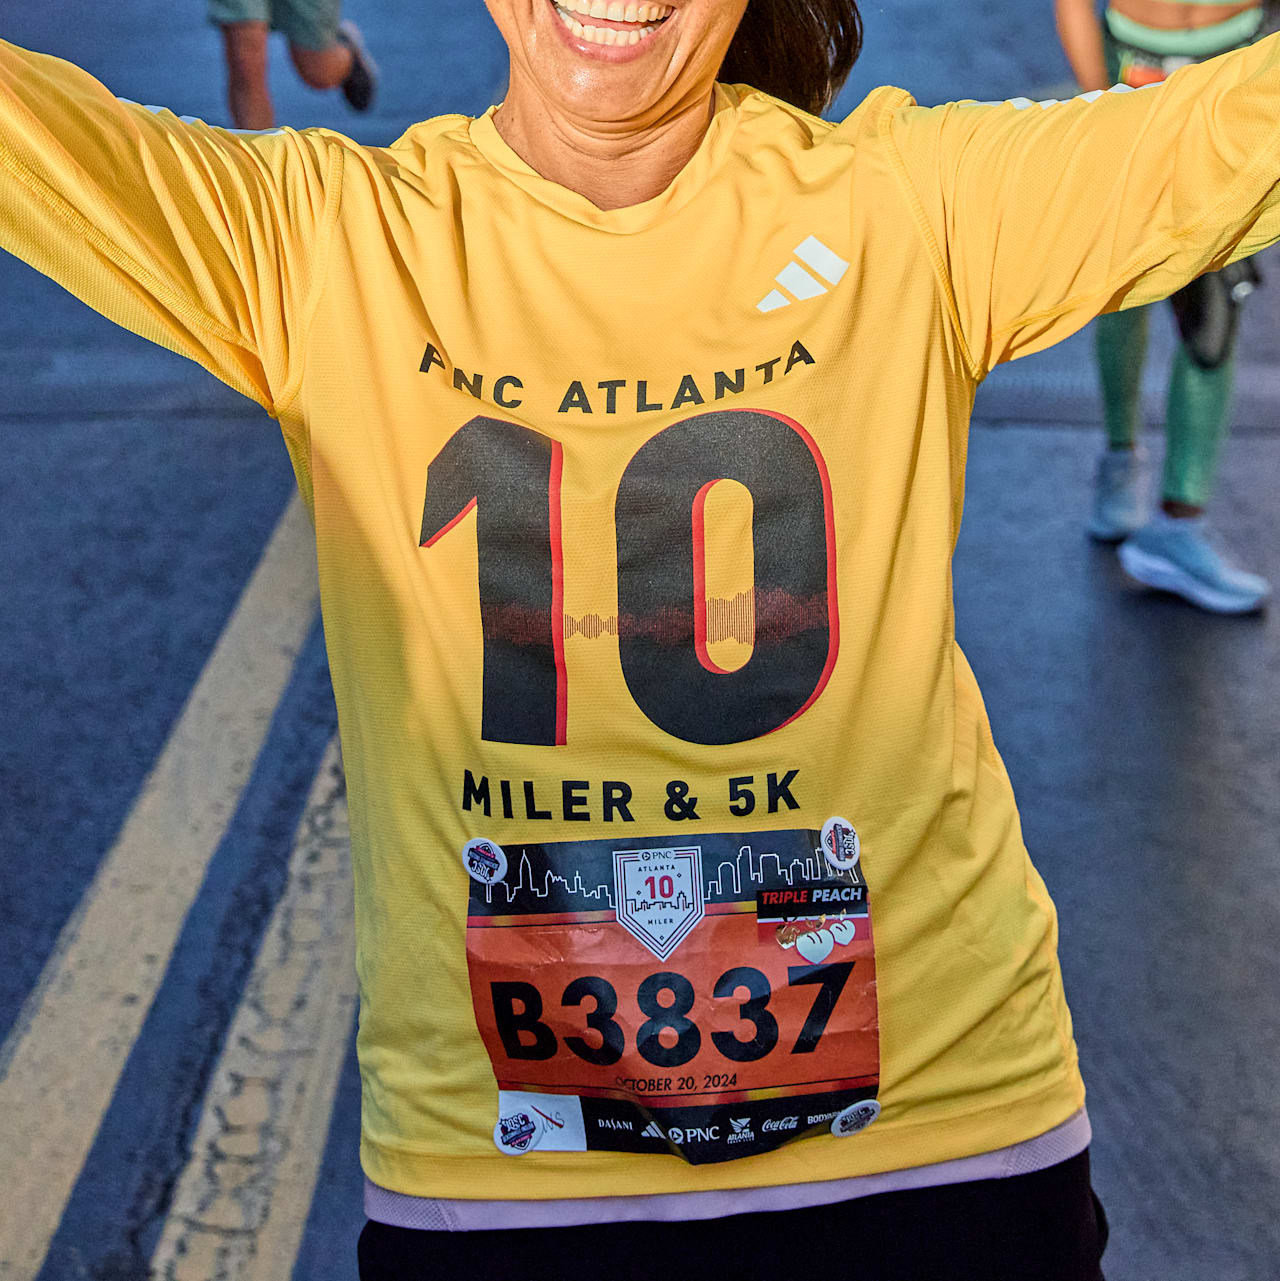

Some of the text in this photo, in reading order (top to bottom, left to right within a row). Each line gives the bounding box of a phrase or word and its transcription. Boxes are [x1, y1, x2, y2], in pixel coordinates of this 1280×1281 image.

[418, 339, 817, 415] PNC ATLANTA
[418, 407, 841, 747] 10
[462, 768, 801, 822] MILER & 5K
[652, 851, 672, 859] PNC
[638, 864, 676, 872] ATLANTA
[644, 875, 674, 899] 10
[762, 887, 862, 905] TRIPLE PEACH
[489, 961, 856, 1068] B3837
[677, 1076, 698, 1091] 20,
[703, 1073, 738, 1089] 2024
[597, 1118, 633, 1131] DASANI
[685, 1126, 720, 1143] PNC
[727, 1131, 755, 1142] ATLANTA
